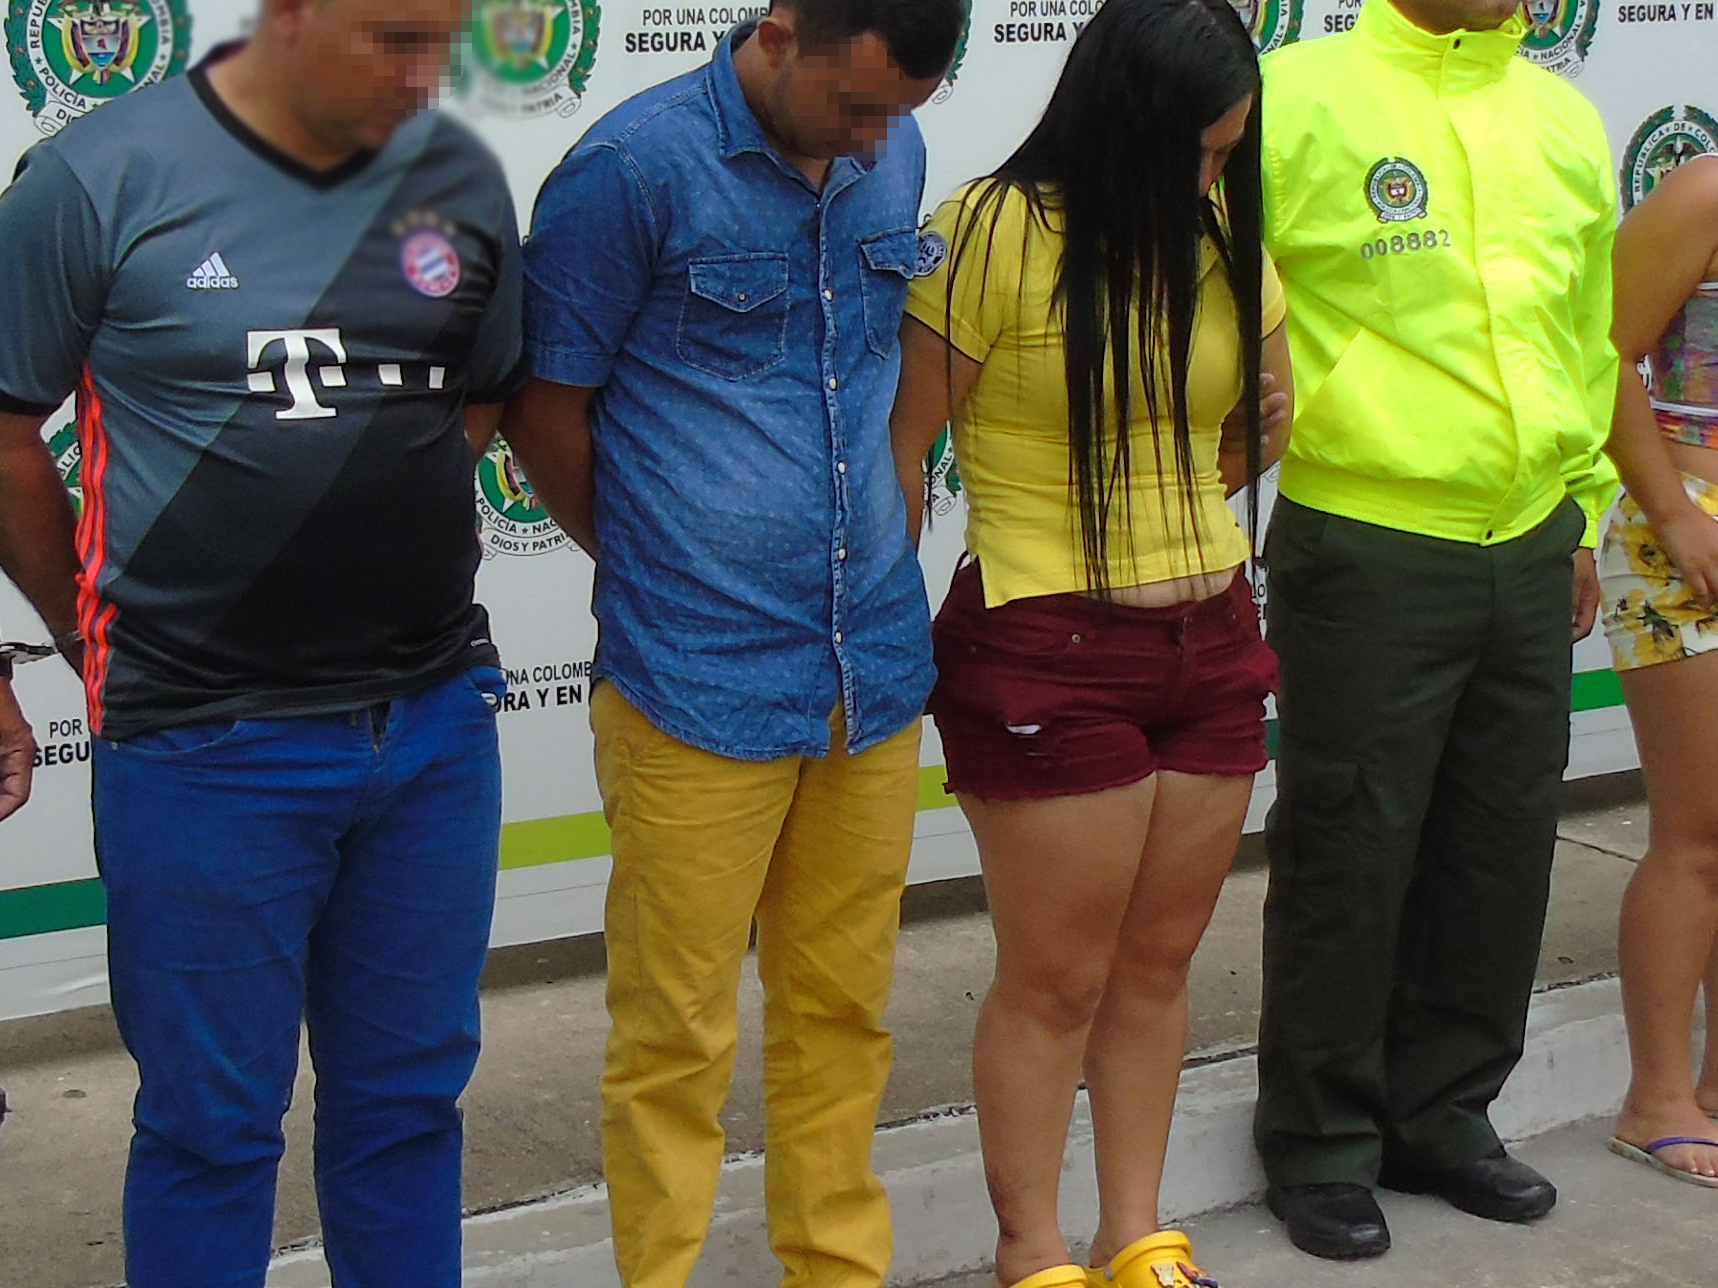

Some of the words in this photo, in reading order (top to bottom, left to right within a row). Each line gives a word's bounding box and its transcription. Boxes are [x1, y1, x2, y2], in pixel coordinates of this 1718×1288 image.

[643, 9, 672, 26] POR
[677, 8, 705, 25] UNA
[1010, 1, 1037, 17] POR
[1040, 0, 1067, 16] UNA
[1070, 0, 1103, 16] COLO
[1618, 4, 1676, 23] SEGURA
[1681, 4, 1691, 20] Y
[1696, 3, 1713, 20] EN
[625, 32, 706, 53] SEGURA
[994, 22, 1067, 43] SEGURA
[1361, 229, 1451, 259] 008882
[186, 275, 239, 289] adidas
[533, 661, 591, 683] COLOMB
[536, 688, 549, 708] Y
[557, 684, 581, 706] EN
[49, 718, 83, 739] POR
